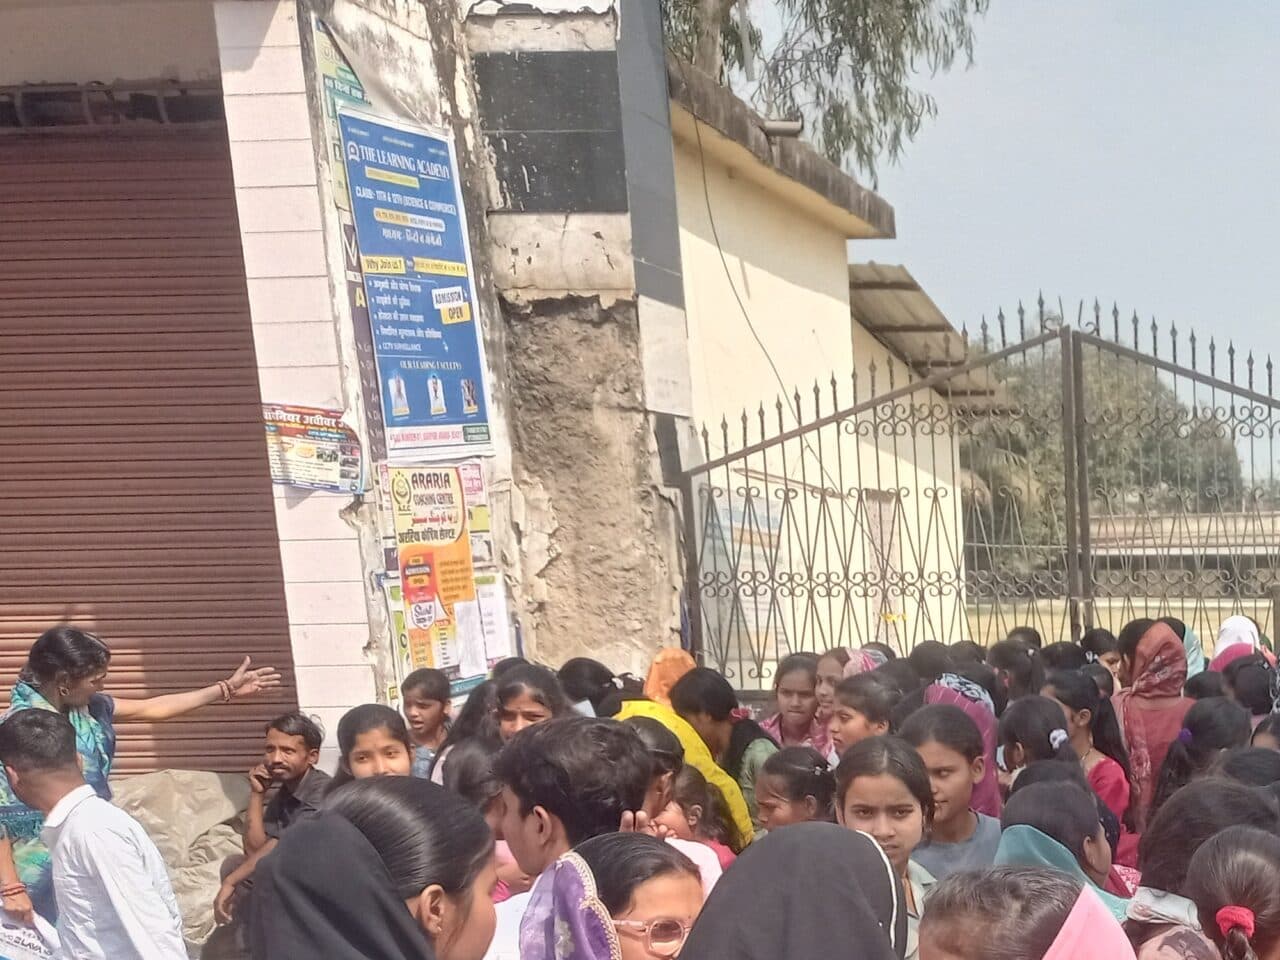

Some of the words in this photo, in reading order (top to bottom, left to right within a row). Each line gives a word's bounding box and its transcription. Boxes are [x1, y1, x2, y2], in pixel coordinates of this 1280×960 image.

[359, 145, 377, 163] THE
[377, 150, 415, 171] LEARNING
[416, 159, 450, 179] ACADEMY
[367, 259, 379, 271] Why
[380, 260, 392, 270] Join
[435, 290, 462, 304] ADMISSION
[448, 306, 464, 319] OPEN
[411, 472, 451, 489] ARARIA
